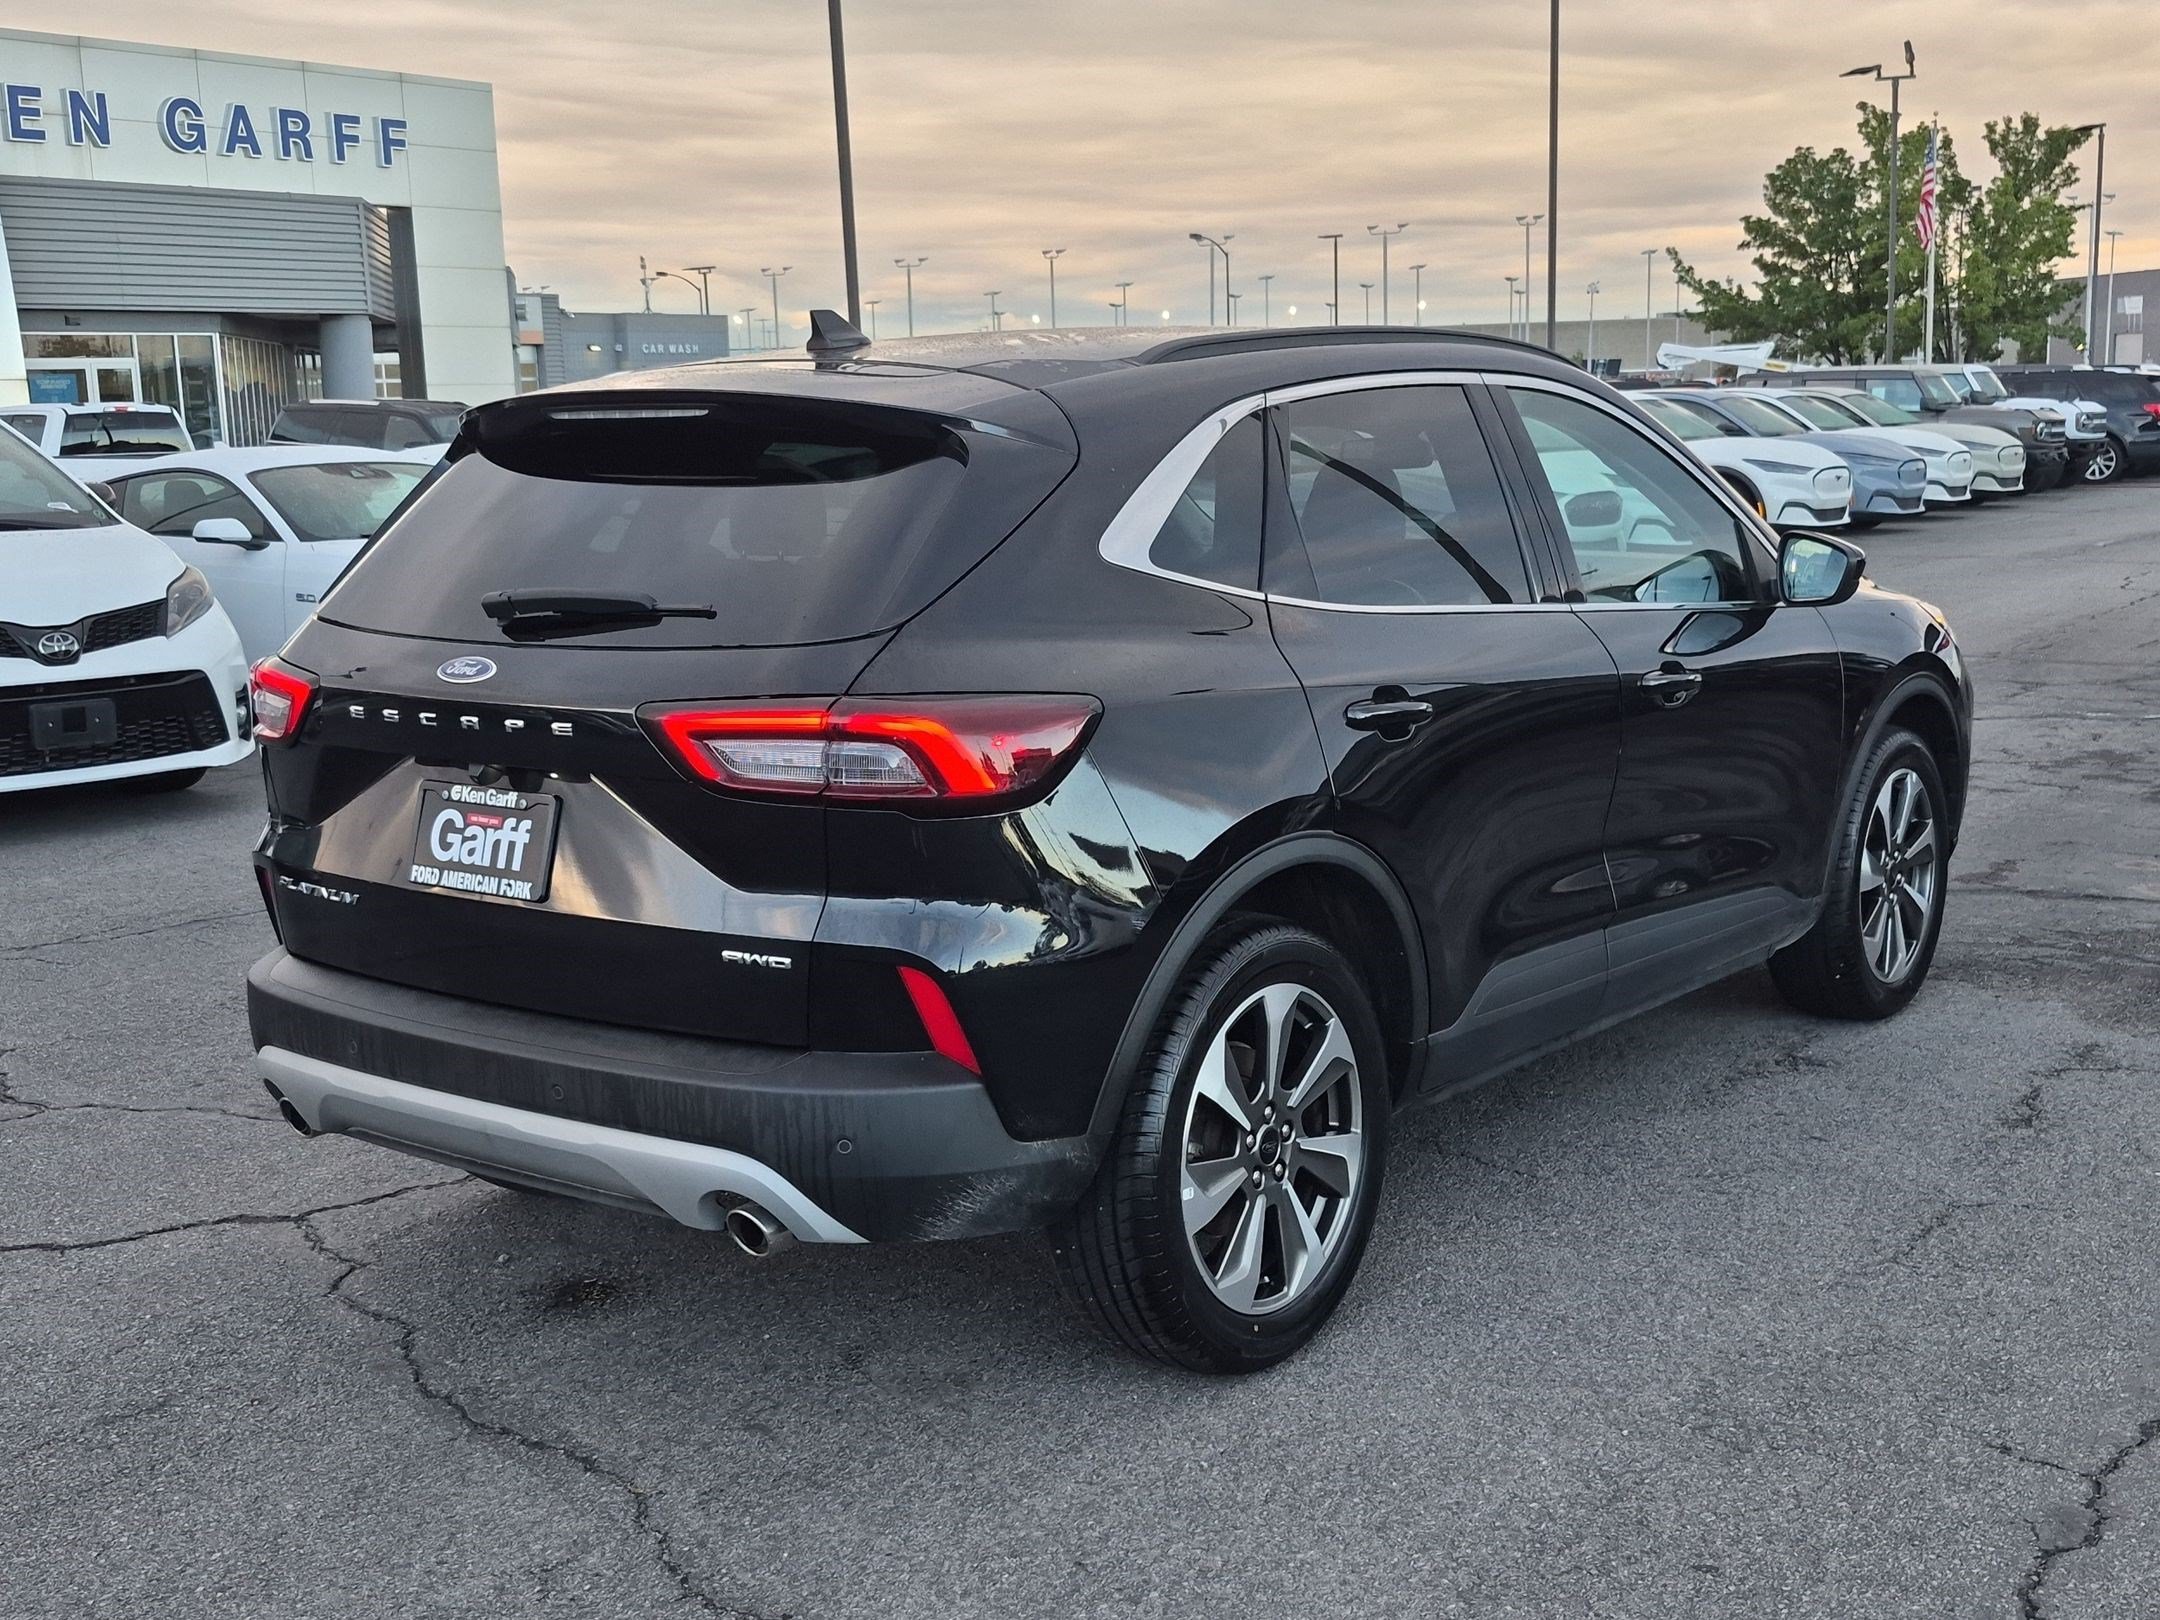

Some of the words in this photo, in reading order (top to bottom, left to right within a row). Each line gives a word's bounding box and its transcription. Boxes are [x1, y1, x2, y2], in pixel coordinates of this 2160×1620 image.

[159, 95, 409, 168] GARFF
[642, 343, 664, 353] CAR
[669, 344, 699, 353] WASH
[446, 659, 482, 676] Ford
[350, 705, 573, 736] ESCAPE
[462, 786, 485, 804] Ken
[486, 788, 518, 808] Garff
[430, 808, 532, 871] Garff
[280, 875, 359, 905] PLATINUM
[411, 865, 440, 885] FORD
[440, 870, 498, 894] AMERICAN
[500, 878, 533, 899] FORK
[722, 950, 792, 969] AWD
